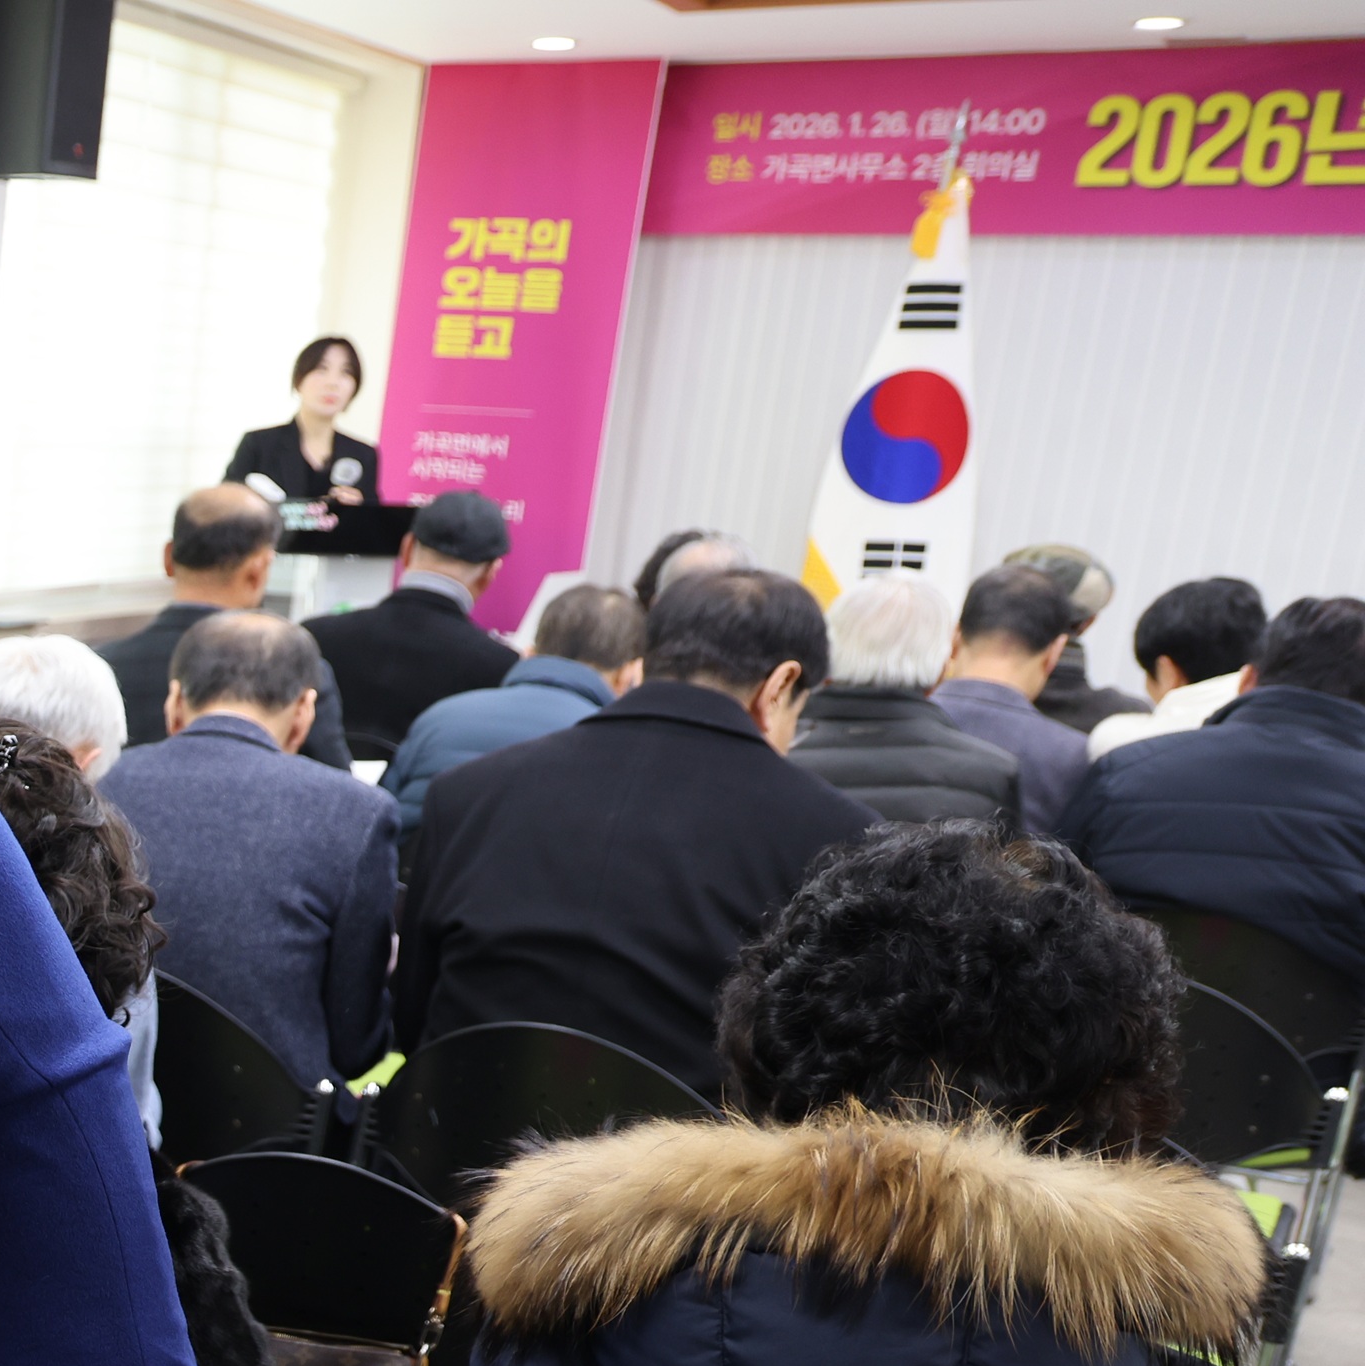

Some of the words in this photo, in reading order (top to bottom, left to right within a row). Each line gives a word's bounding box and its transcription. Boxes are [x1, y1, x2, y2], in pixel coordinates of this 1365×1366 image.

[712, 109, 764, 143] 일시
[768, 110, 845, 141] 2026.
[968, 105, 1048, 136] 14:00
[443, 216, 574, 265] 가곡의
[437, 265, 565, 315] 오늘을
